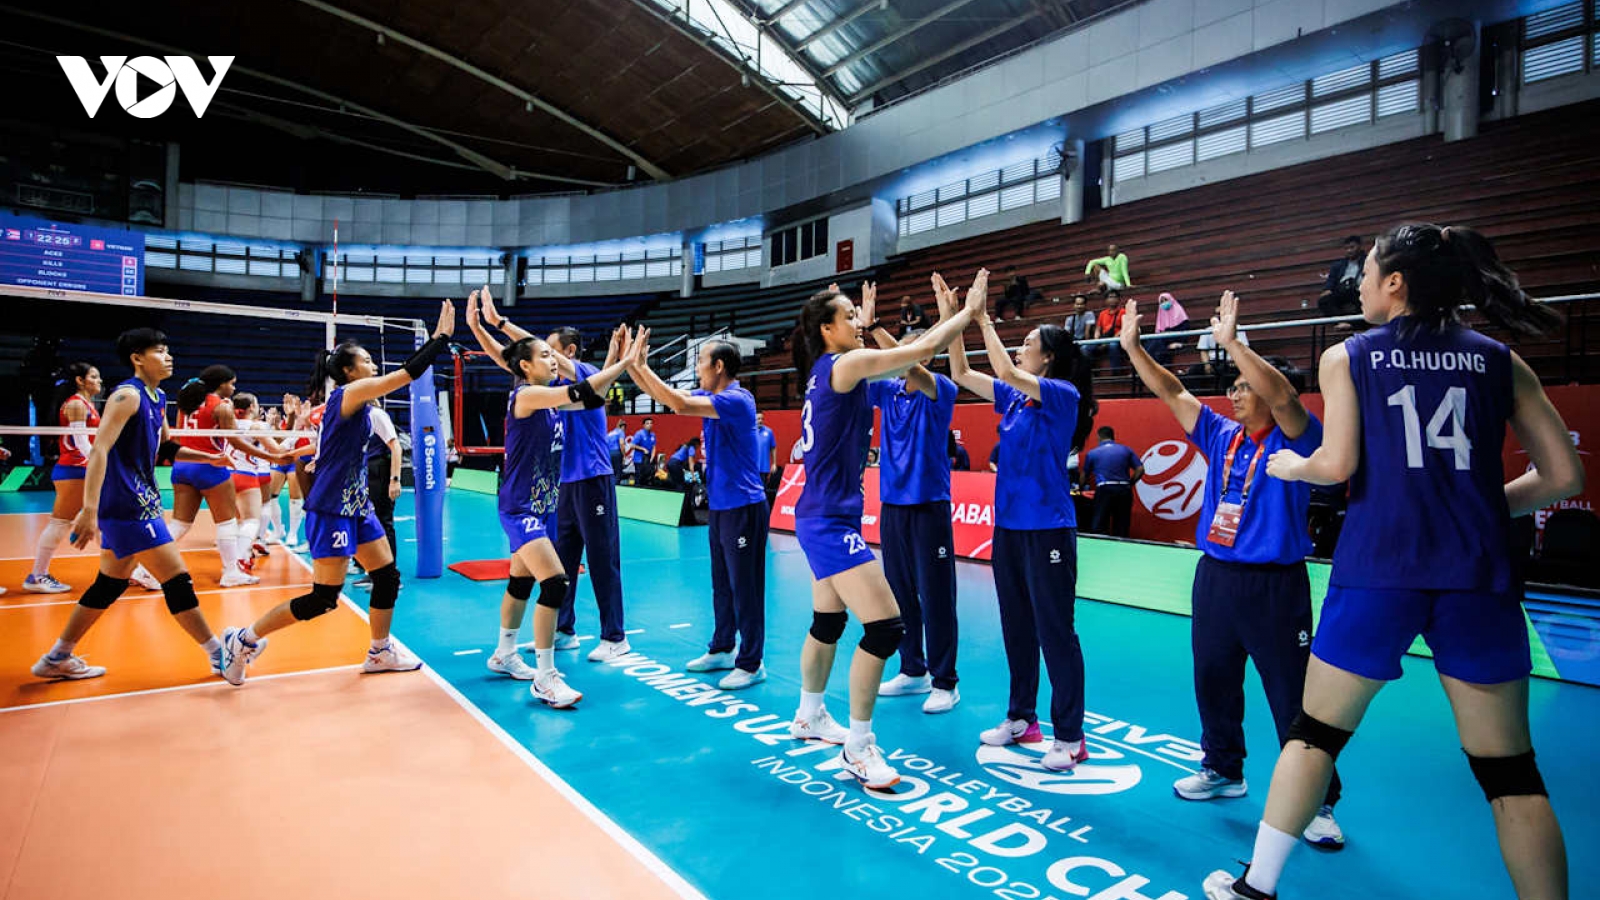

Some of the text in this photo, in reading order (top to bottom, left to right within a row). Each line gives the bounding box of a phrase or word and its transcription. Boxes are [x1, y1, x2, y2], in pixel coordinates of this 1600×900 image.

[37, 234, 52, 243] 22
[54, 236, 70, 246] 25
[16, 278, 57, 287] OPPONENT
[1370, 349, 1486, 374] P.Q.HUONG
[1387, 384, 1474, 471] 14
[424, 447, 436, 490] Senoh
[1151, 479, 1203, 515] 21
[522, 516, 541, 533] 22
[951, 502, 996, 526] ABA
[145, 523, 156, 538] 1
[332, 531, 348, 548] 20
[843, 532, 866, 555] 23
[609, 652, 760, 718] WOMEN'S
[814, 755, 1047, 857] ORLD
[887, 748, 1093, 843] VOLLEYBALL
[751, 756, 1052, 900] INDONESIA 202
